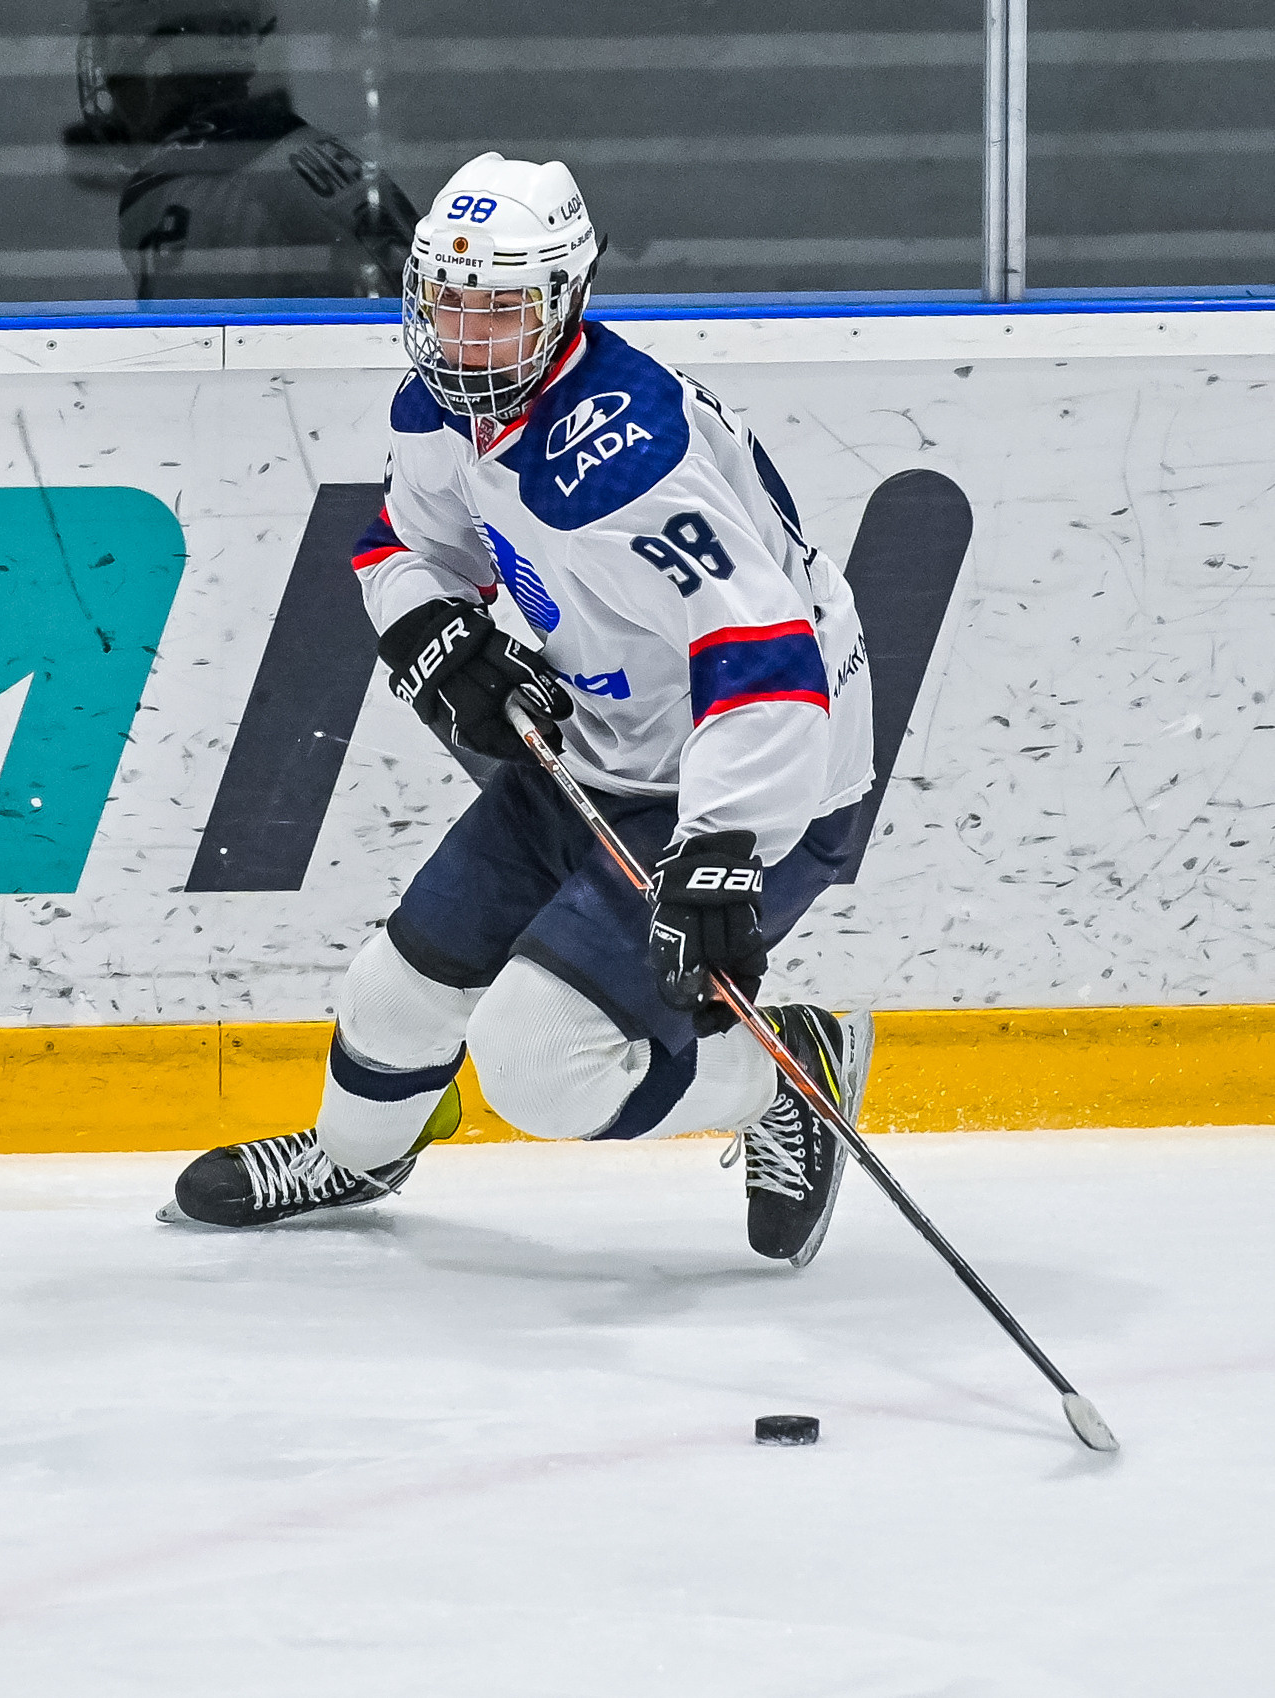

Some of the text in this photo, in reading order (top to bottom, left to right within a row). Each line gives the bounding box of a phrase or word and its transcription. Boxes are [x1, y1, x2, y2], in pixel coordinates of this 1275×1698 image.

[447, 195, 498, 224] 98
[434, 252, 484, 269] OLIMPBET
[554, 422, 654, 498] LADA
[629, 510, 737, 599] 98
[395, 616, 471, 703] AUER
[833, 632, 867, 699] MARA
[685, 866, 763, 893] BAU
